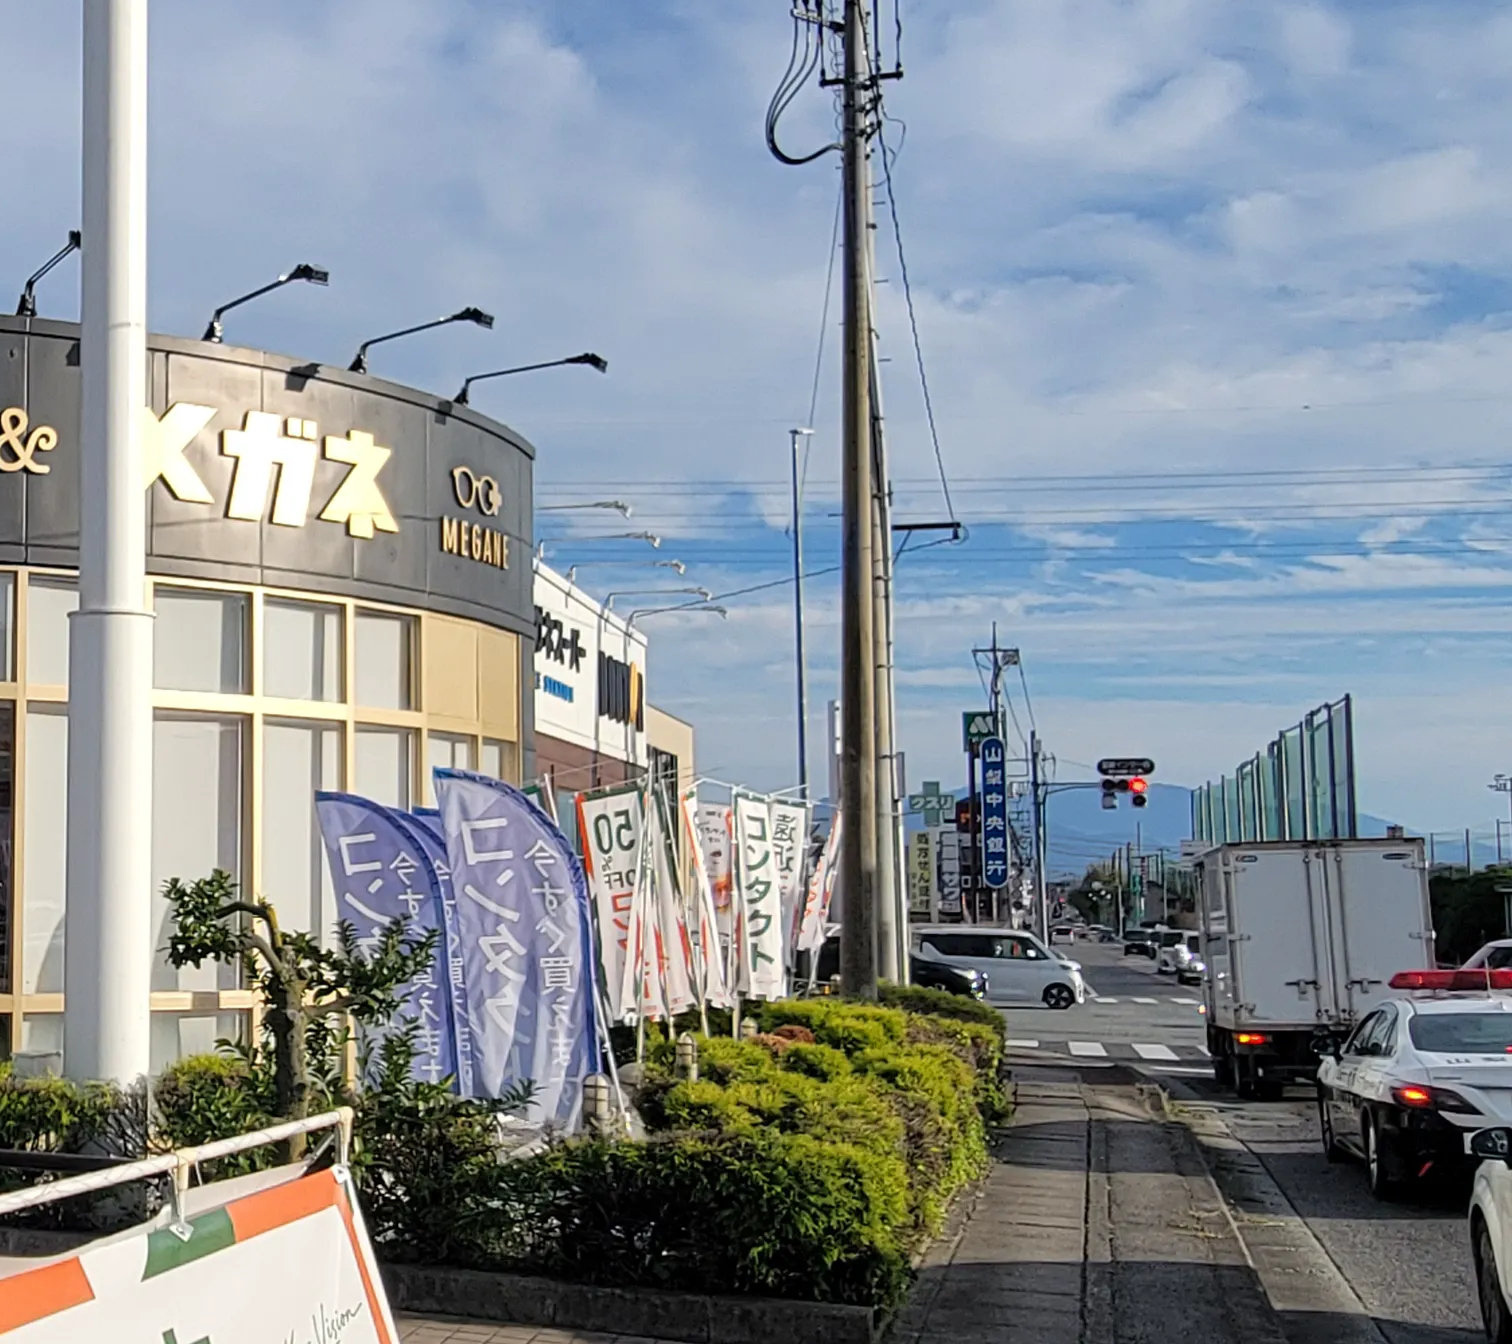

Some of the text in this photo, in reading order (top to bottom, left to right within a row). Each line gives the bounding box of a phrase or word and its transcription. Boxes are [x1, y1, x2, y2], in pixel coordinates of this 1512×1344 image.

[441, 515, 511, 572] MEGANE
[984, 746, 1007, 877] 山梨中央銀行
[745, 813, 775, 973] コンタクト
